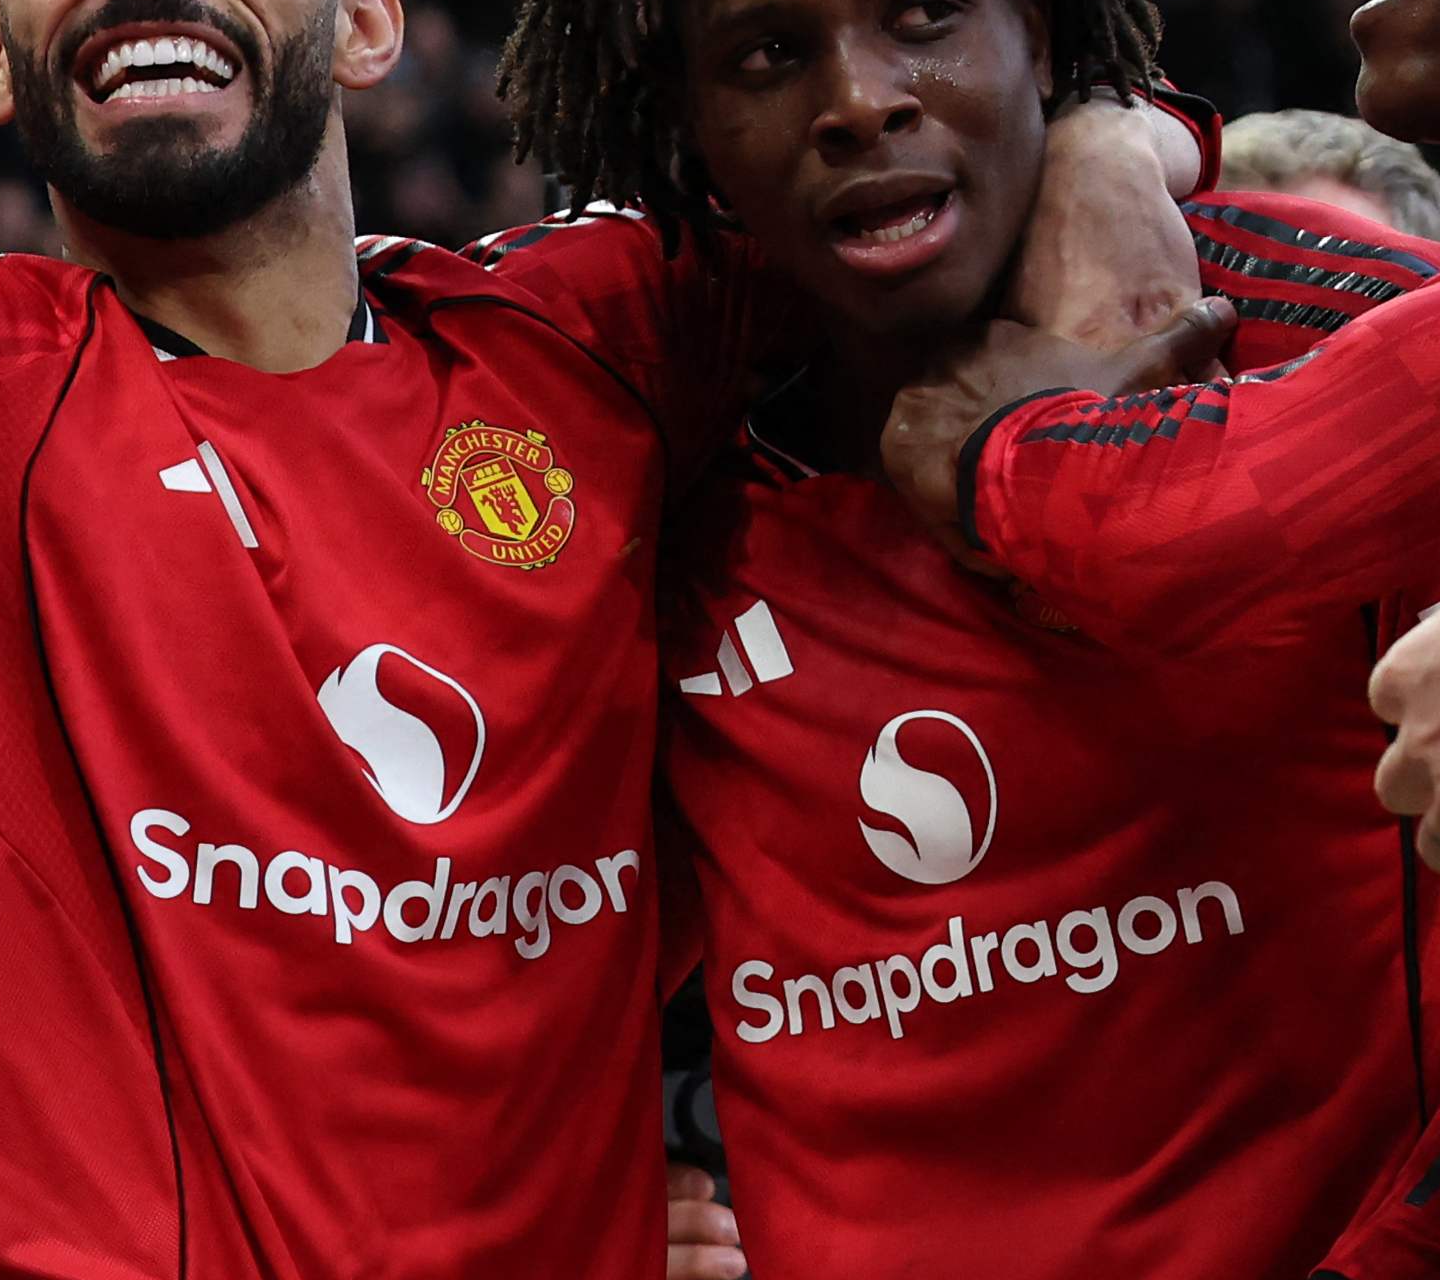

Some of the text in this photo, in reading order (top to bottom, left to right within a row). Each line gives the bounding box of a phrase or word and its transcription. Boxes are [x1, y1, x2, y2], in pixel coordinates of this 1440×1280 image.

[435, 431, 541, 496] MANCHESTER
[491, 523, 564, 561] UNITED
[731, 880, 1245, 1043] Snapdragon
